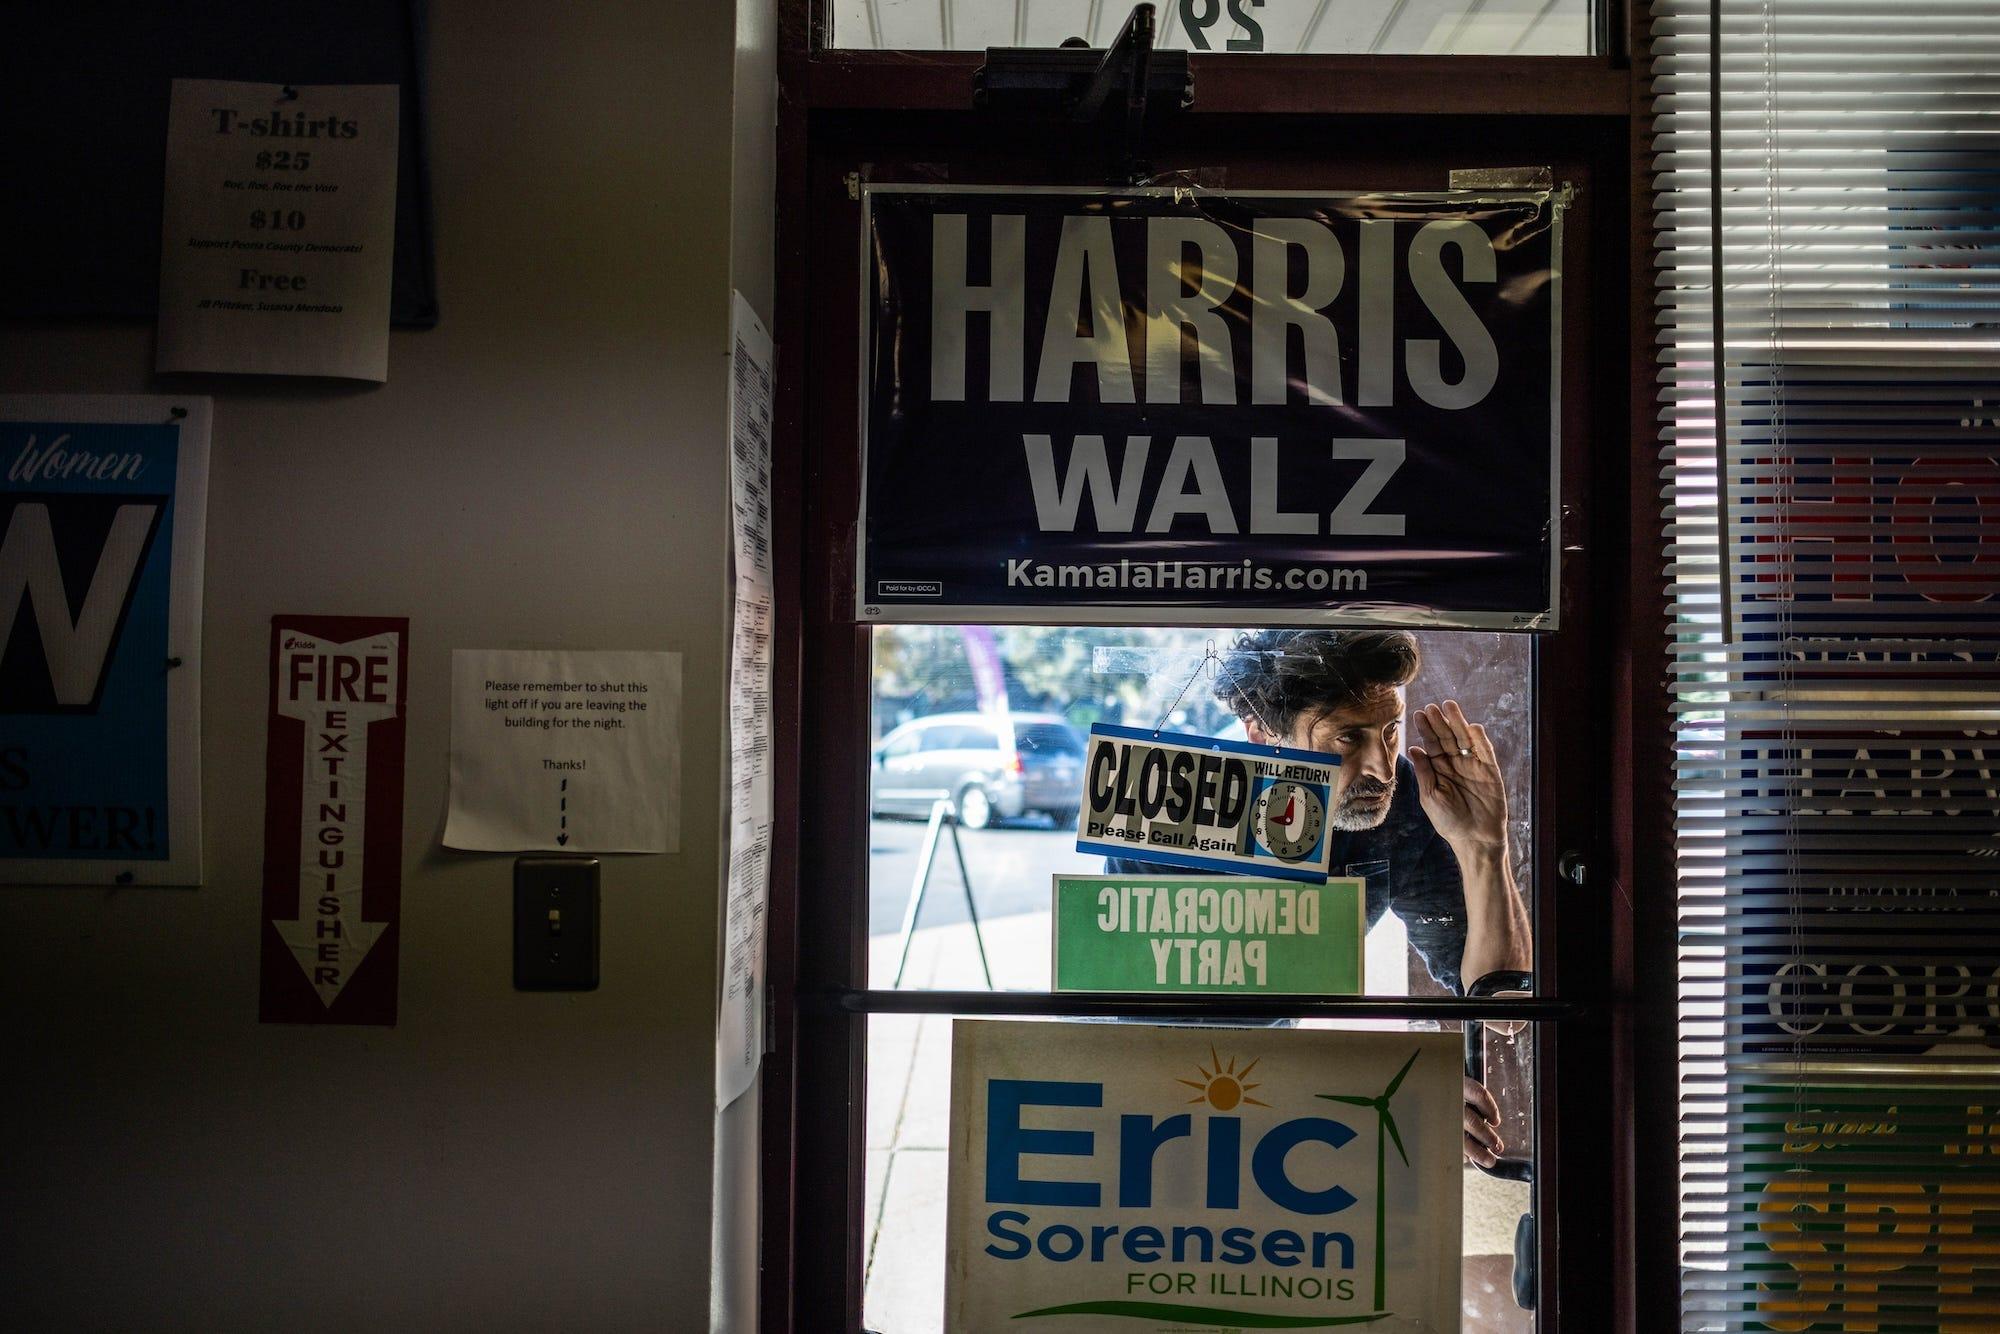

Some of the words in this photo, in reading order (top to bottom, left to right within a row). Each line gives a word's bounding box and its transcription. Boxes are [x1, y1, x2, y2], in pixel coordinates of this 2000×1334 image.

[211, 109, 359, 139] T-shirts
[255, 150, 311, 171] $25
[295, 183, 313, 192] the
[314, 183, 338, 193] Vote
[249, 209, 306, 231] $10
[187, 238, 229, 250] Support
[231, 240, 264, 250] Peoria
[266, 242, 304, 253] County
[238, 269, 307, 291] Free
[295, 303, 343, 313] Mendoza
[930, 212, 1500, 411] HARRIS
[9, 432, 149, 482] Women
[1022, 434, 1407, 536] WALZ
[1007, 558, 1368, 591] KamalaHarris.com
[908, 584, 915, 592] by
[290, 654, 388, 702] FIRE
[485, 680, 520, 691] Please
[523, 681, 583, 692] remember
[586, 683, 597, 692] to
[600, 682, 625, 693] shut
[628, 682, 648, 693] this
[485, 699, 509, 711] light
[512, 699, 528, 709] off
[531, 699, 539, 709] if
[541, 701, 561, 711] you
[564, 701, 583, 710] are
[586, 700, 626, 712] leaving
[629, 700, 647, 711] the
[504, 717, 550, 730] building
[552, 717, 568, 728] for
[572, 718, 590, 728] the
[594, 718, 626, 731] night.
[543, 759, 587, 770] Thanks!
[1253, 761, 1283, 777] WILL
[1284, 765, 1330, 783] RETURN
[1089, 741, 1248, 829] CLOSED
[1287, 785, 1296, 793] 12
[1256, 799, 1266, 807] 10
[315, 710, 348, 985] EXTINGUISHER
[1087, 822, 1146, 840] Please
[1151, 830, 1184, 845] Call
[1188, 834, 1237, 853] Again
[1266, 840, 1272, 848] 7
[1308, 834, 1314, 842] 4
[1281, 847, 1287, 855] 6
[985, 1078, 1358, 1216] Eric
[984, 1210, 1355, 1270] Sorensen
[1127, 1272, 1196, 1295] FOR
[1211, 1273, 1355, 1301] ILLINOIS
